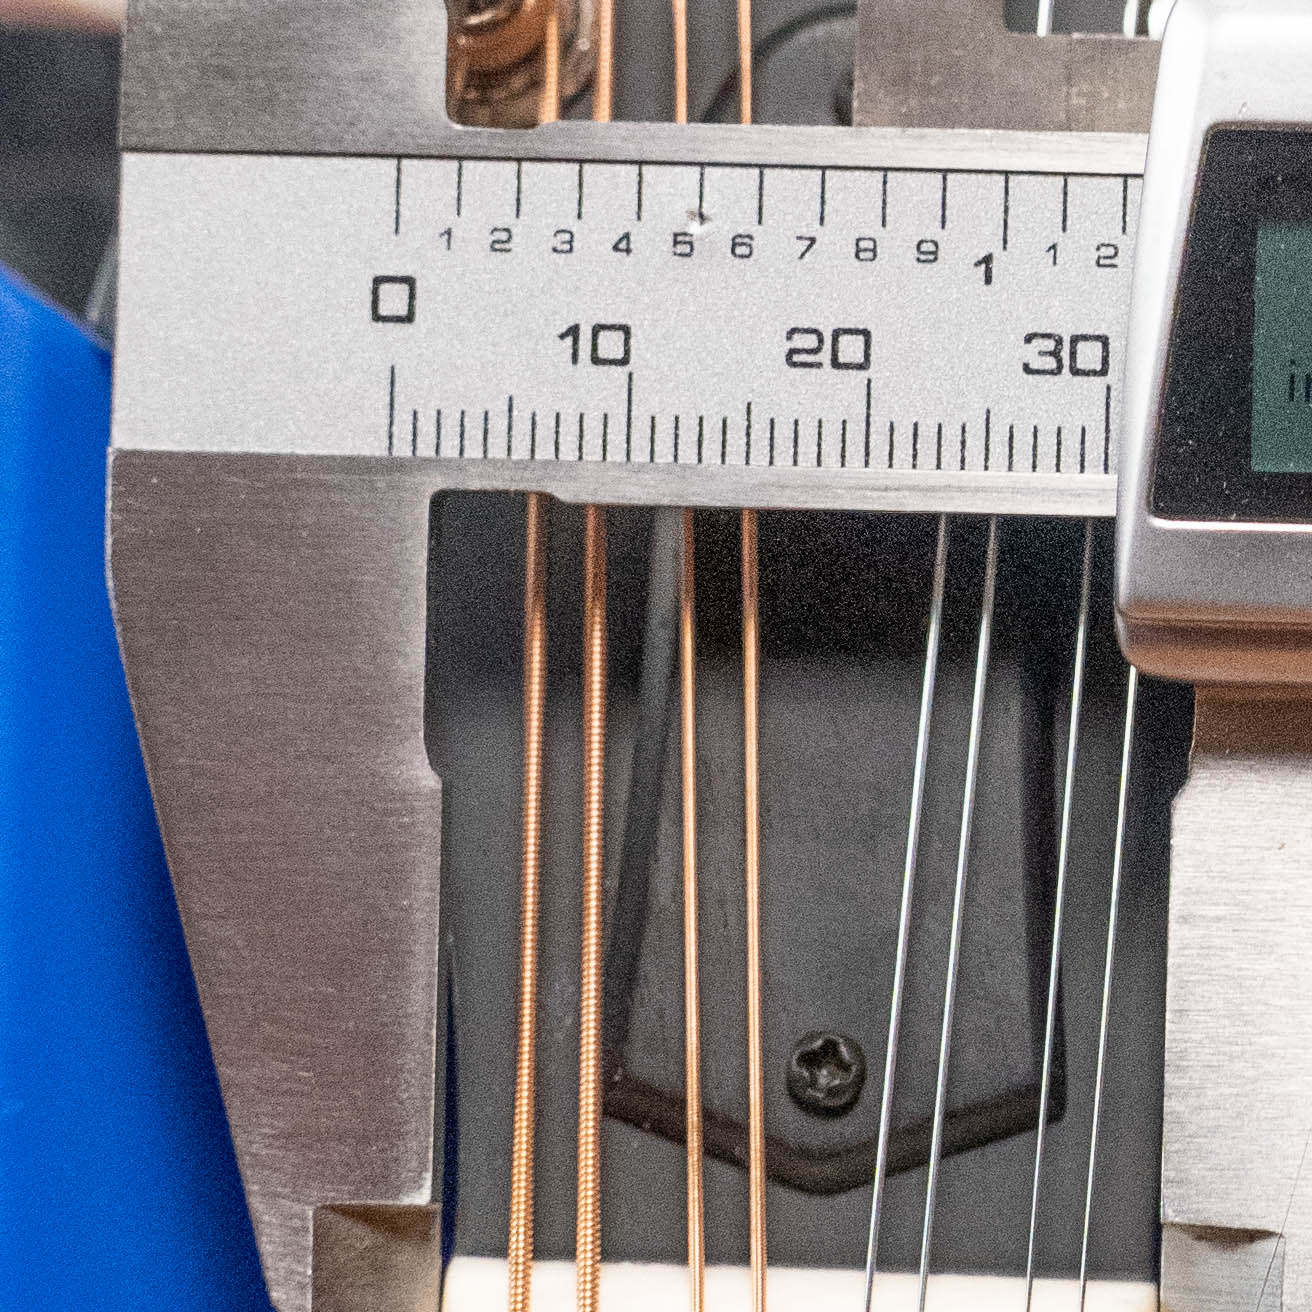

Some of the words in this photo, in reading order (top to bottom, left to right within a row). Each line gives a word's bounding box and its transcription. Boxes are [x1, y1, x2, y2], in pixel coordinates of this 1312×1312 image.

[438, 227, 453, 252] 1
[489, 227, 514, 253] 2
[551, 229, 575, 255] 3
[611, 231, 634, 256] 4
[672, 233, 695, 258] 5
[730, 234, 754, 259] 6
[795, 236, 818, 261] 7
[854, 237, 879, 262] 8
[915, 239, 939, 264] 9
[973, 253, 994, 286] 1
[1045, 243, 1059, 267] 1
[1095, 243, 1120, 268] 2
[371, 275, 416, 323] 0
[557, 323, 632, 367] 10
[785, 327, 872, 371] 20
[1022, 332, 1110, 377] 30
